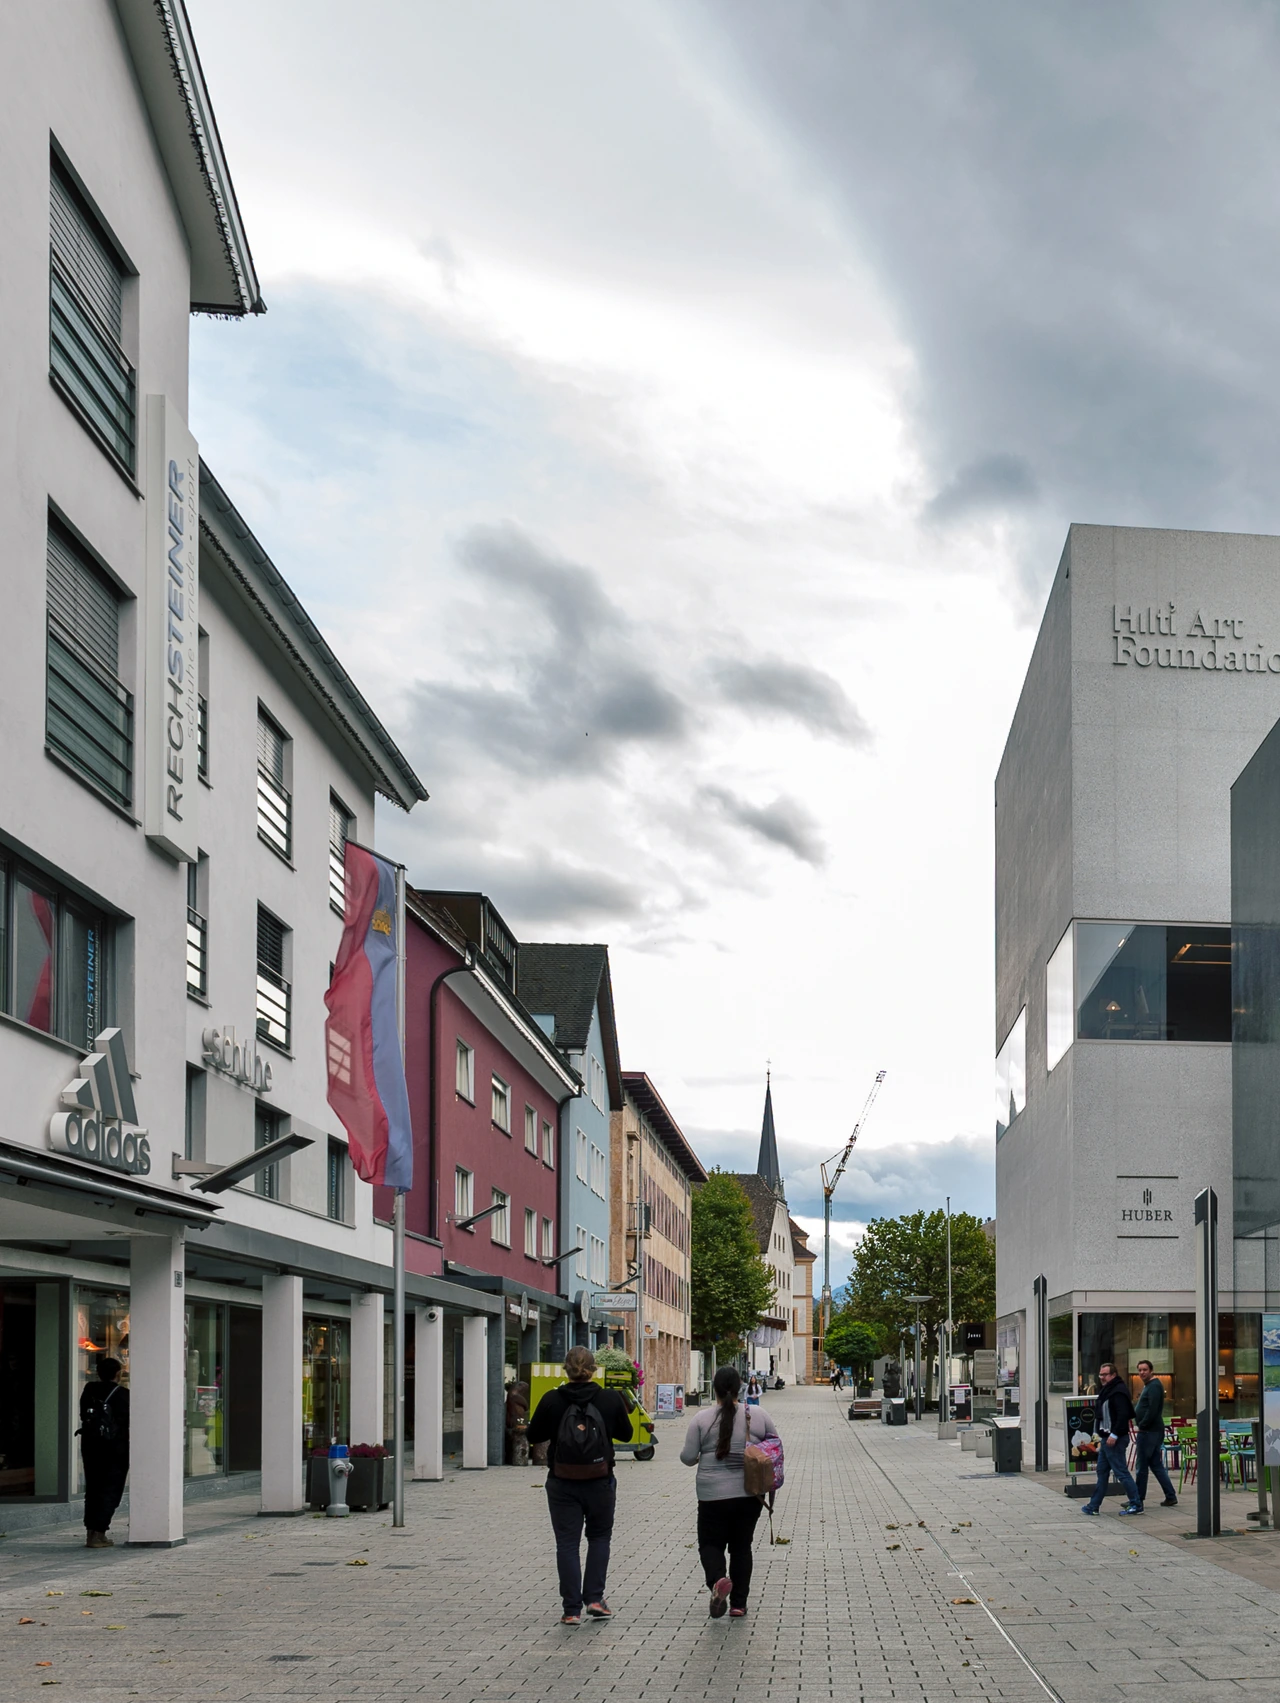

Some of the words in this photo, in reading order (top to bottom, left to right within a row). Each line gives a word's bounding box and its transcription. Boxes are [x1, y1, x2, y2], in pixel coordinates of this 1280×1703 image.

[187, 458, 197, 527] sport
[186, 551, 195, 623] mode
[1112, 601, 1177, 636] Hilti
[1186, 611, 1243, 639] Art
[168, 459, 184, 822] RECHSTEINER
[185, 648, 195, 740] schuhe
[87, 929, 95, 1052] RECHSTEINER
[52, 1110, 151, 1175] adidas
[1121, 1209, 1174, 1222] HUBER
